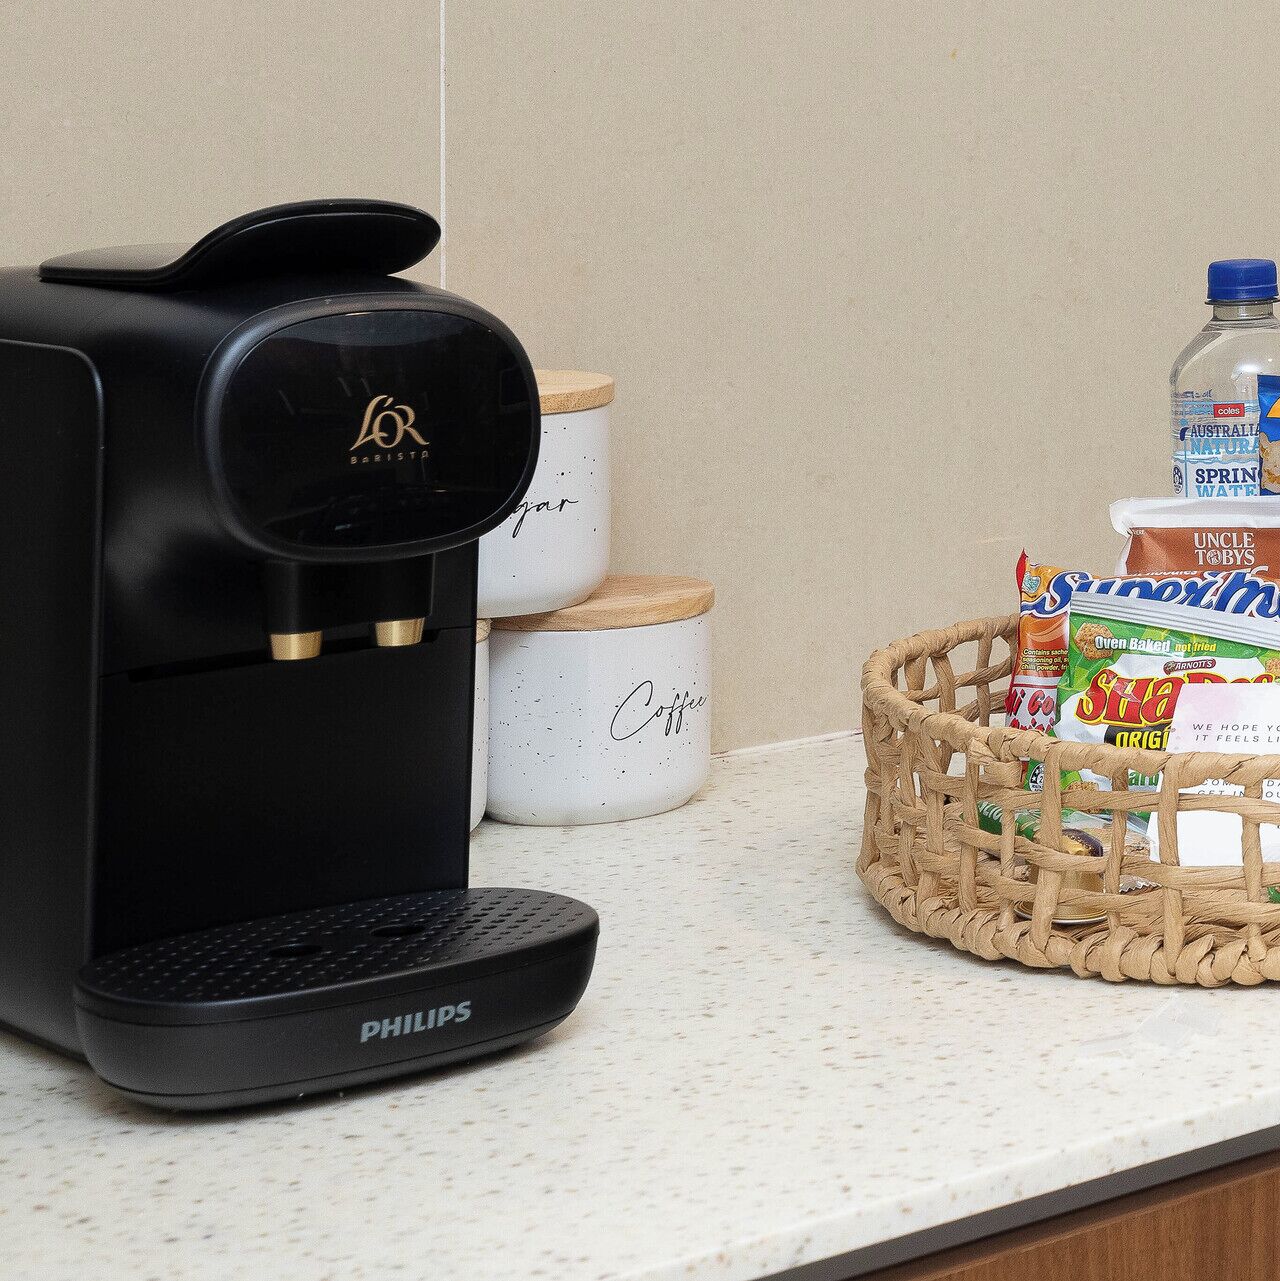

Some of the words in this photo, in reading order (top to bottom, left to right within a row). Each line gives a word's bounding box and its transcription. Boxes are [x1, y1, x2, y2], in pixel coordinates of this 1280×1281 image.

[1217, 407, 1240, 415] coles
[1190, 423, 1260, 438] AUSTRALIA
[1195, 466, 1260, 484] SPRIN
[1196, 483, 1257, 497] WATE
[514, 498, 579, 538] gar
[1194, 532, 1255, 549] UNCLE
[1195, 548, 1256, 566] TOBYS
[1095, 635, 1127, 650] Oven
[1129, 637, 1171, 652] Baked
[1174, 642, 1193, 652] not
[1193, 641, 1217, 652] fried
[1175, 660, 1213, 671] ARNOTT'S
[610, 680, 707, 741] Coffee
[1192, 723, 1213, 731] WE
[1220, 724, 1258, 732] HOPE
[1195, 734, 1209, 742] IT
[1216, 734, 1260, 743] FEELS
[360, 1000, 472, 1044] PHILIPS
